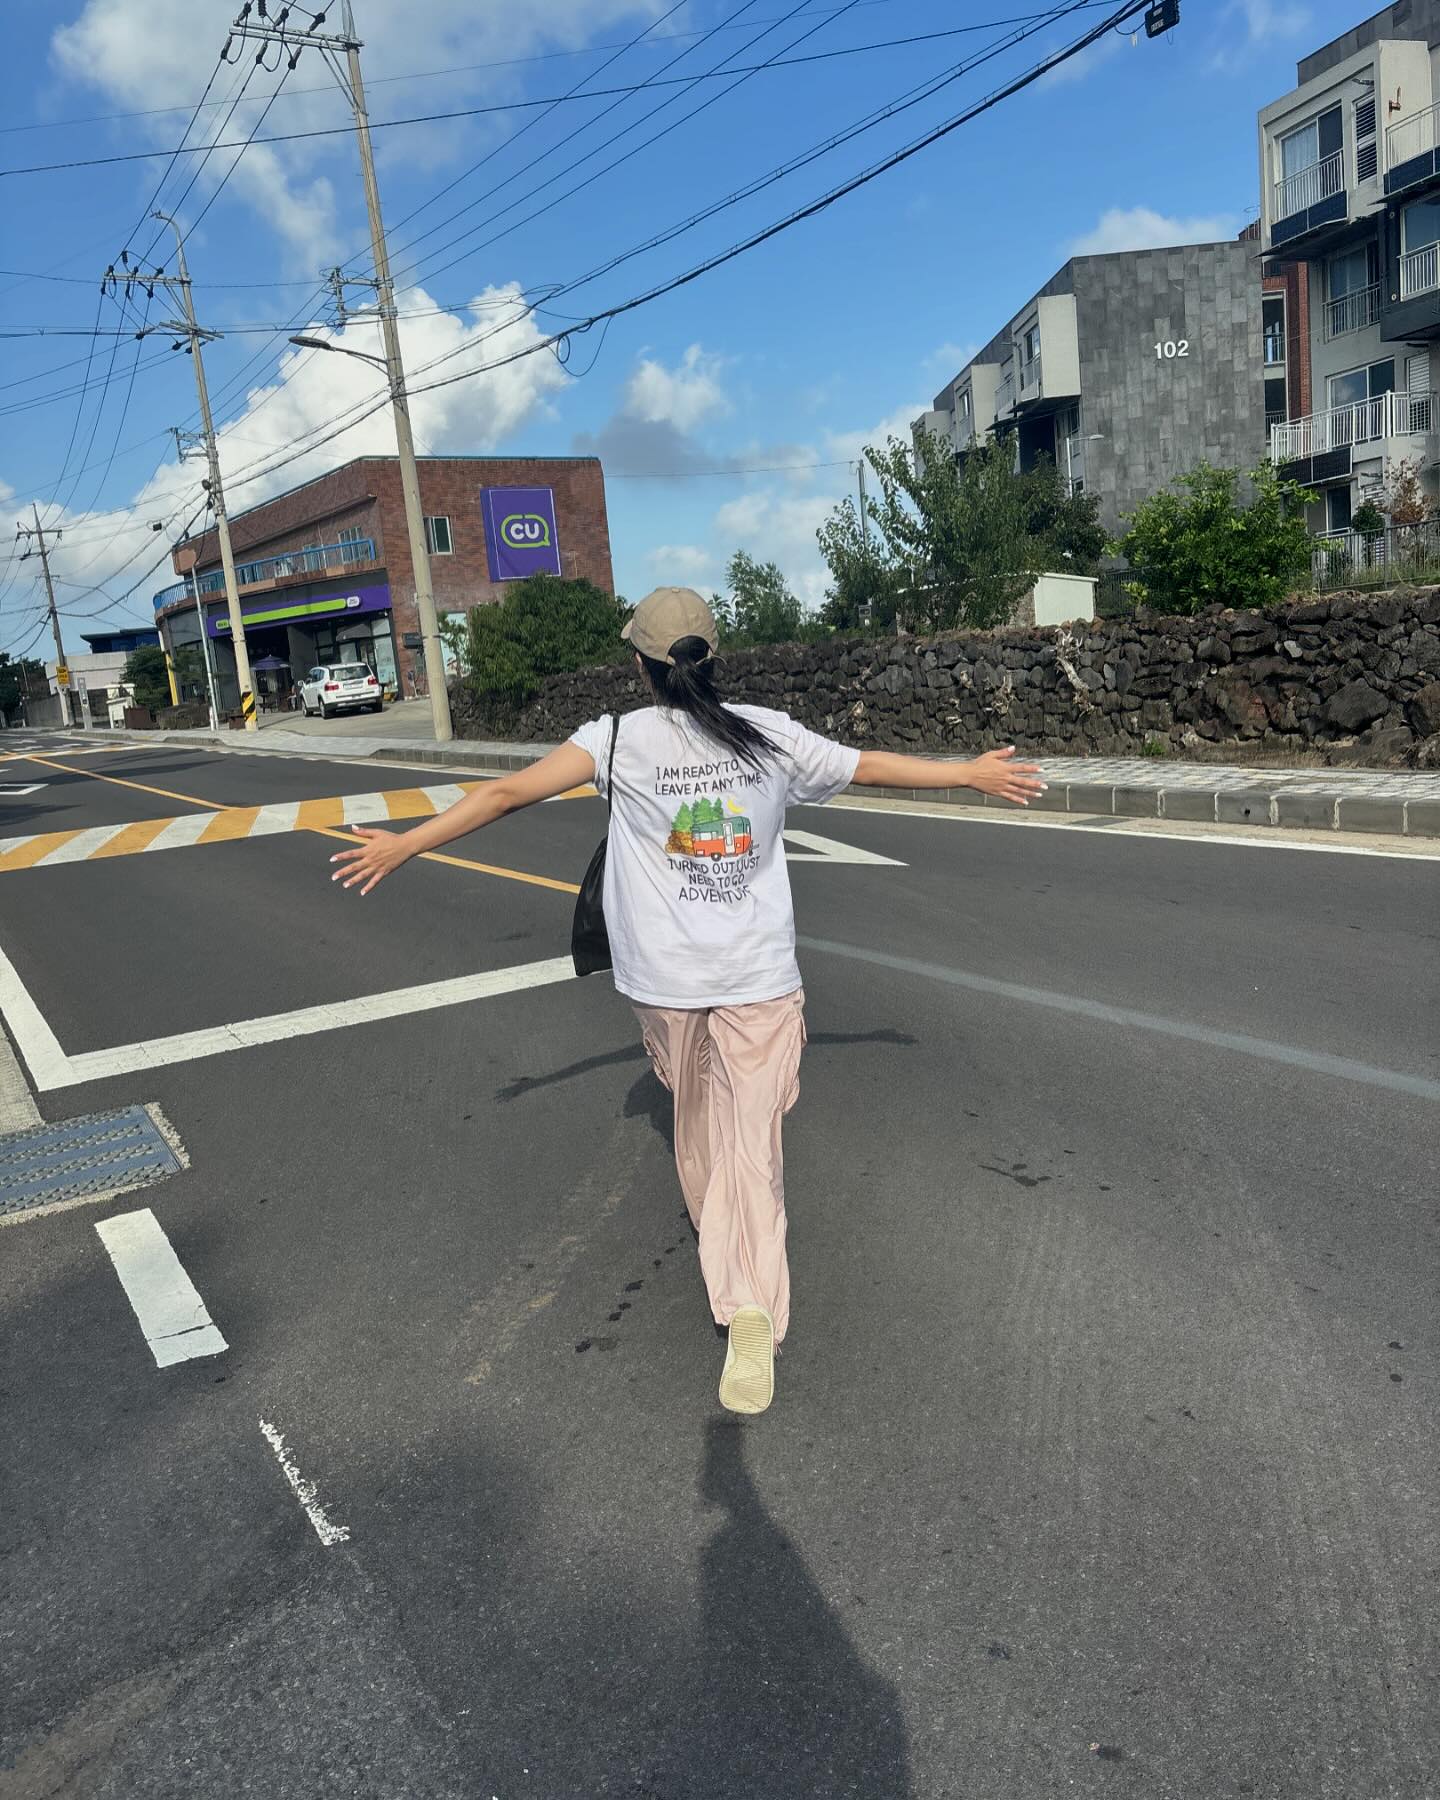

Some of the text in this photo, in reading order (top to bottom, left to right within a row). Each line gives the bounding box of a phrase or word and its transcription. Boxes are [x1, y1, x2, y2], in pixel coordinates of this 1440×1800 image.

[1154, 340, 1189, 360] 102
[510, 523, 540, 540] CU
[656, 758, 739, 780] I AM READY TO
[655, 772, 763, 796] LEAVE AT ANY TIME
[667, 858, 709, 875] TURNED
[712, 861, 735, 875] OUT
[738, 856, 761, 873] JUST
[688, 873, 745, 889] NEED TO GO
